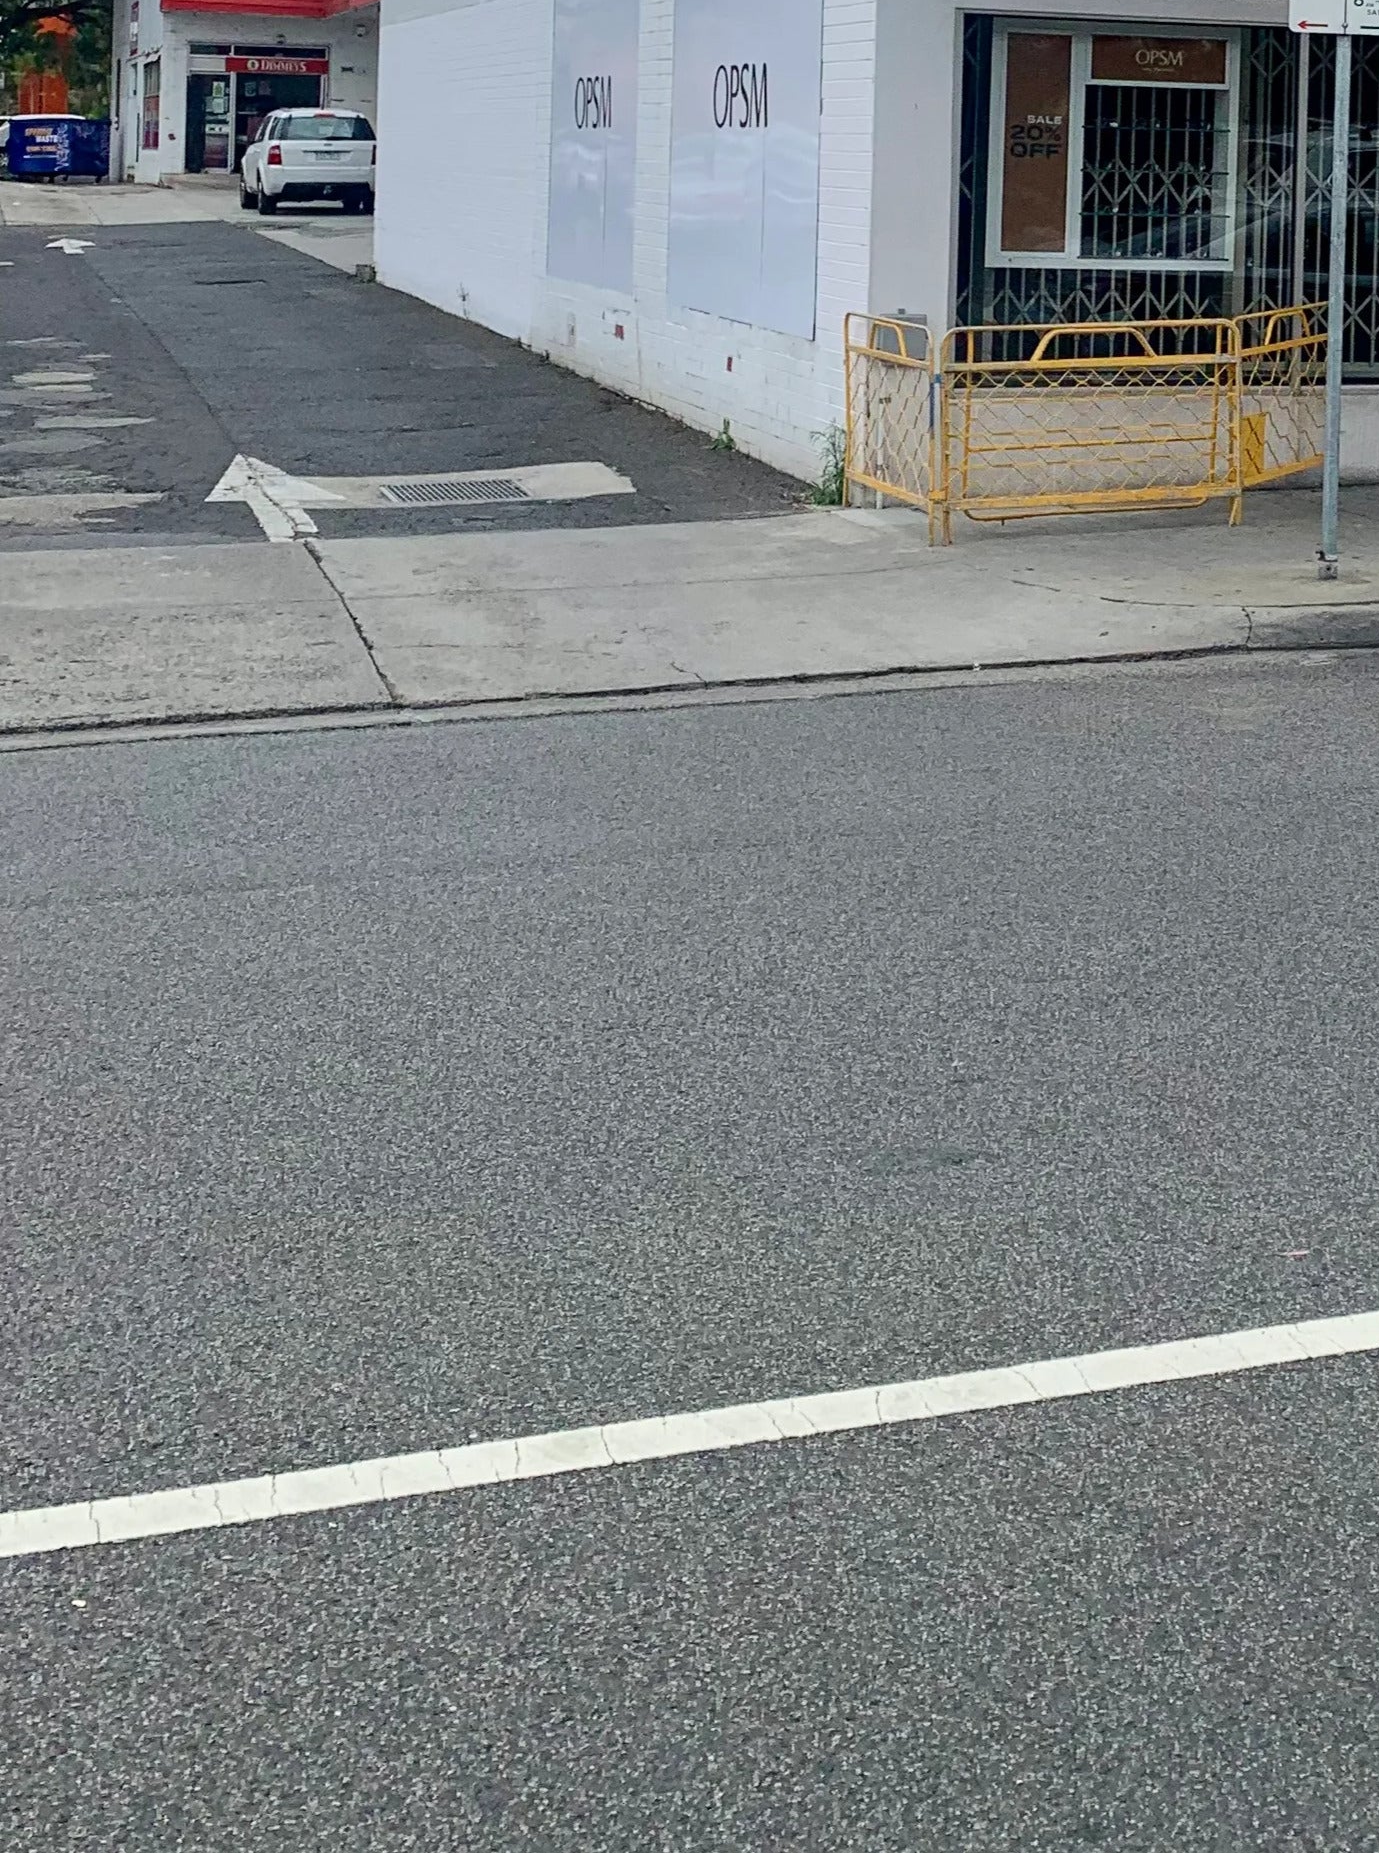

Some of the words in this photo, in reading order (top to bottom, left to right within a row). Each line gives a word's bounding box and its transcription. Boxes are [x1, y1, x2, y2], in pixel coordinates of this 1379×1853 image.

[1135, 49, 1184, 67] OPSM
[574, 75, 612, 130] OPSM
[713, 62, 768, 129] OPSM
[1027, 114, 1063, 126] SALE
[1009, 124, 1061, 142] 20%
[1009, 142, 1059, 159] OFF
